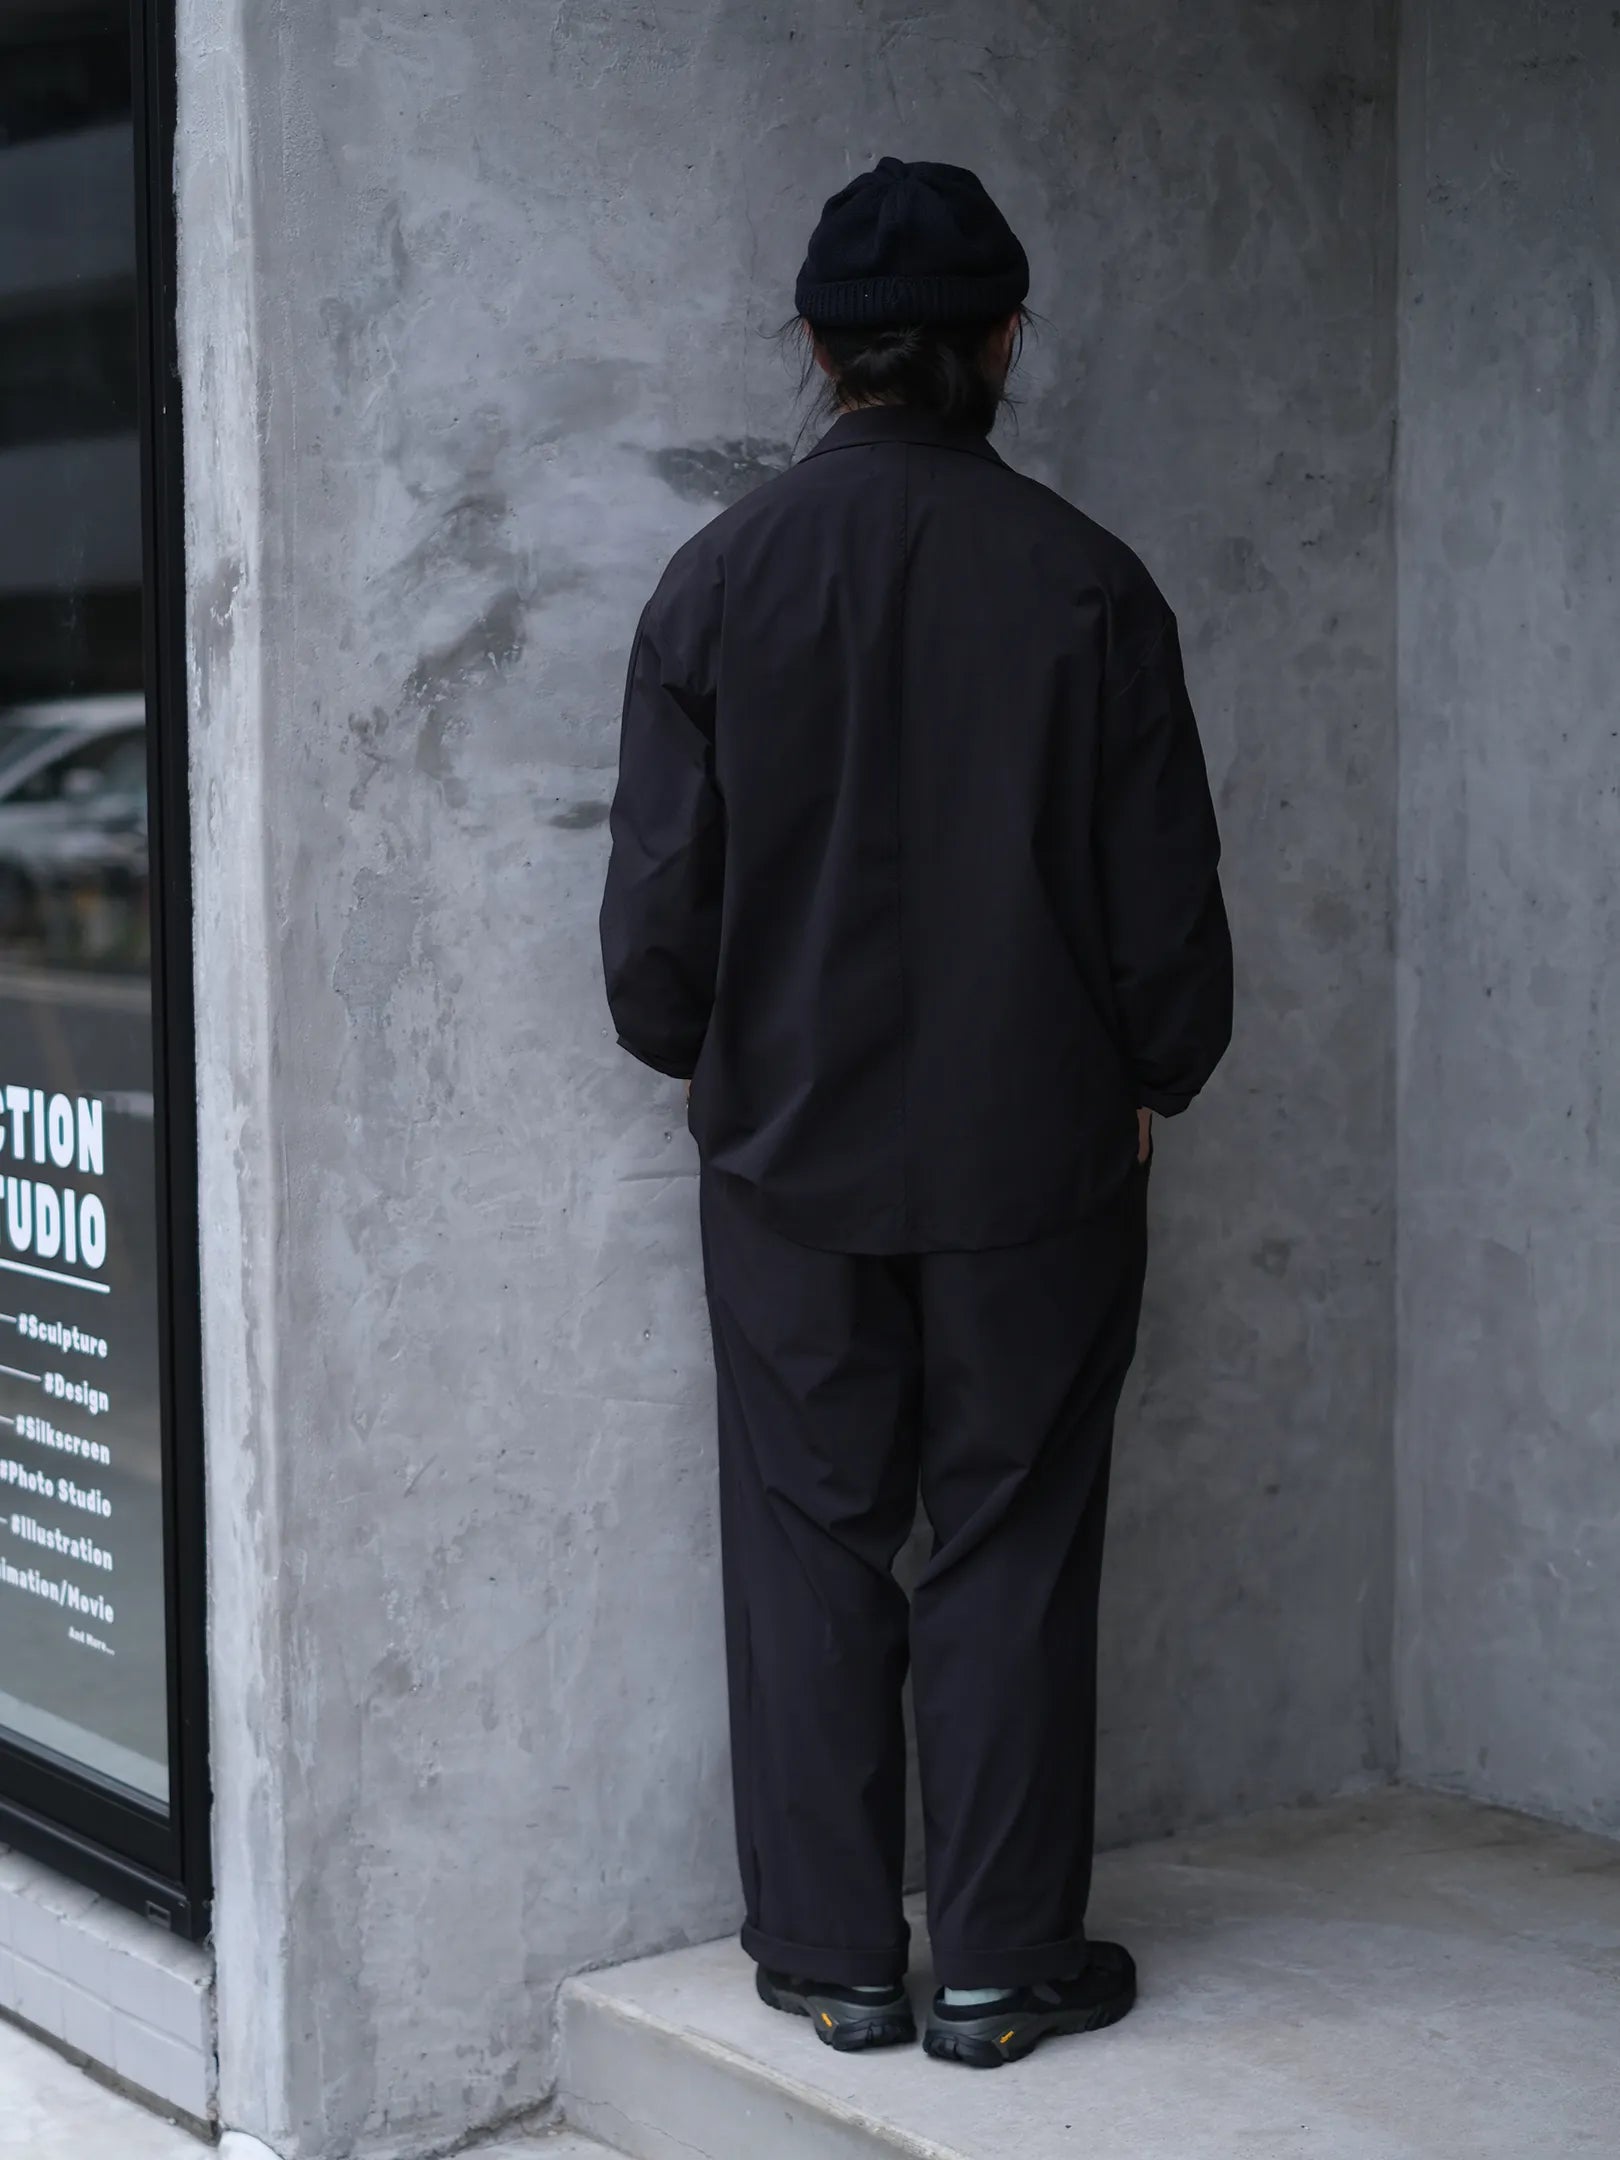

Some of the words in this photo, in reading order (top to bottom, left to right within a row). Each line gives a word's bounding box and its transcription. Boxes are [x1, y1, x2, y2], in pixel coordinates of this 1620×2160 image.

[0, 1085, 104, 1175] TION
[0, 1174, 107, 1269] UDIO
[18, 1312, 108, 1358] #Sculpture
[44, 1371, 109, 1416] #Design
[16, 1414, 111, 1465] #Silkscreen
[58, 1477, 112, 1518] Studio
[0, 1556, 114, 1624] imation/Movie
